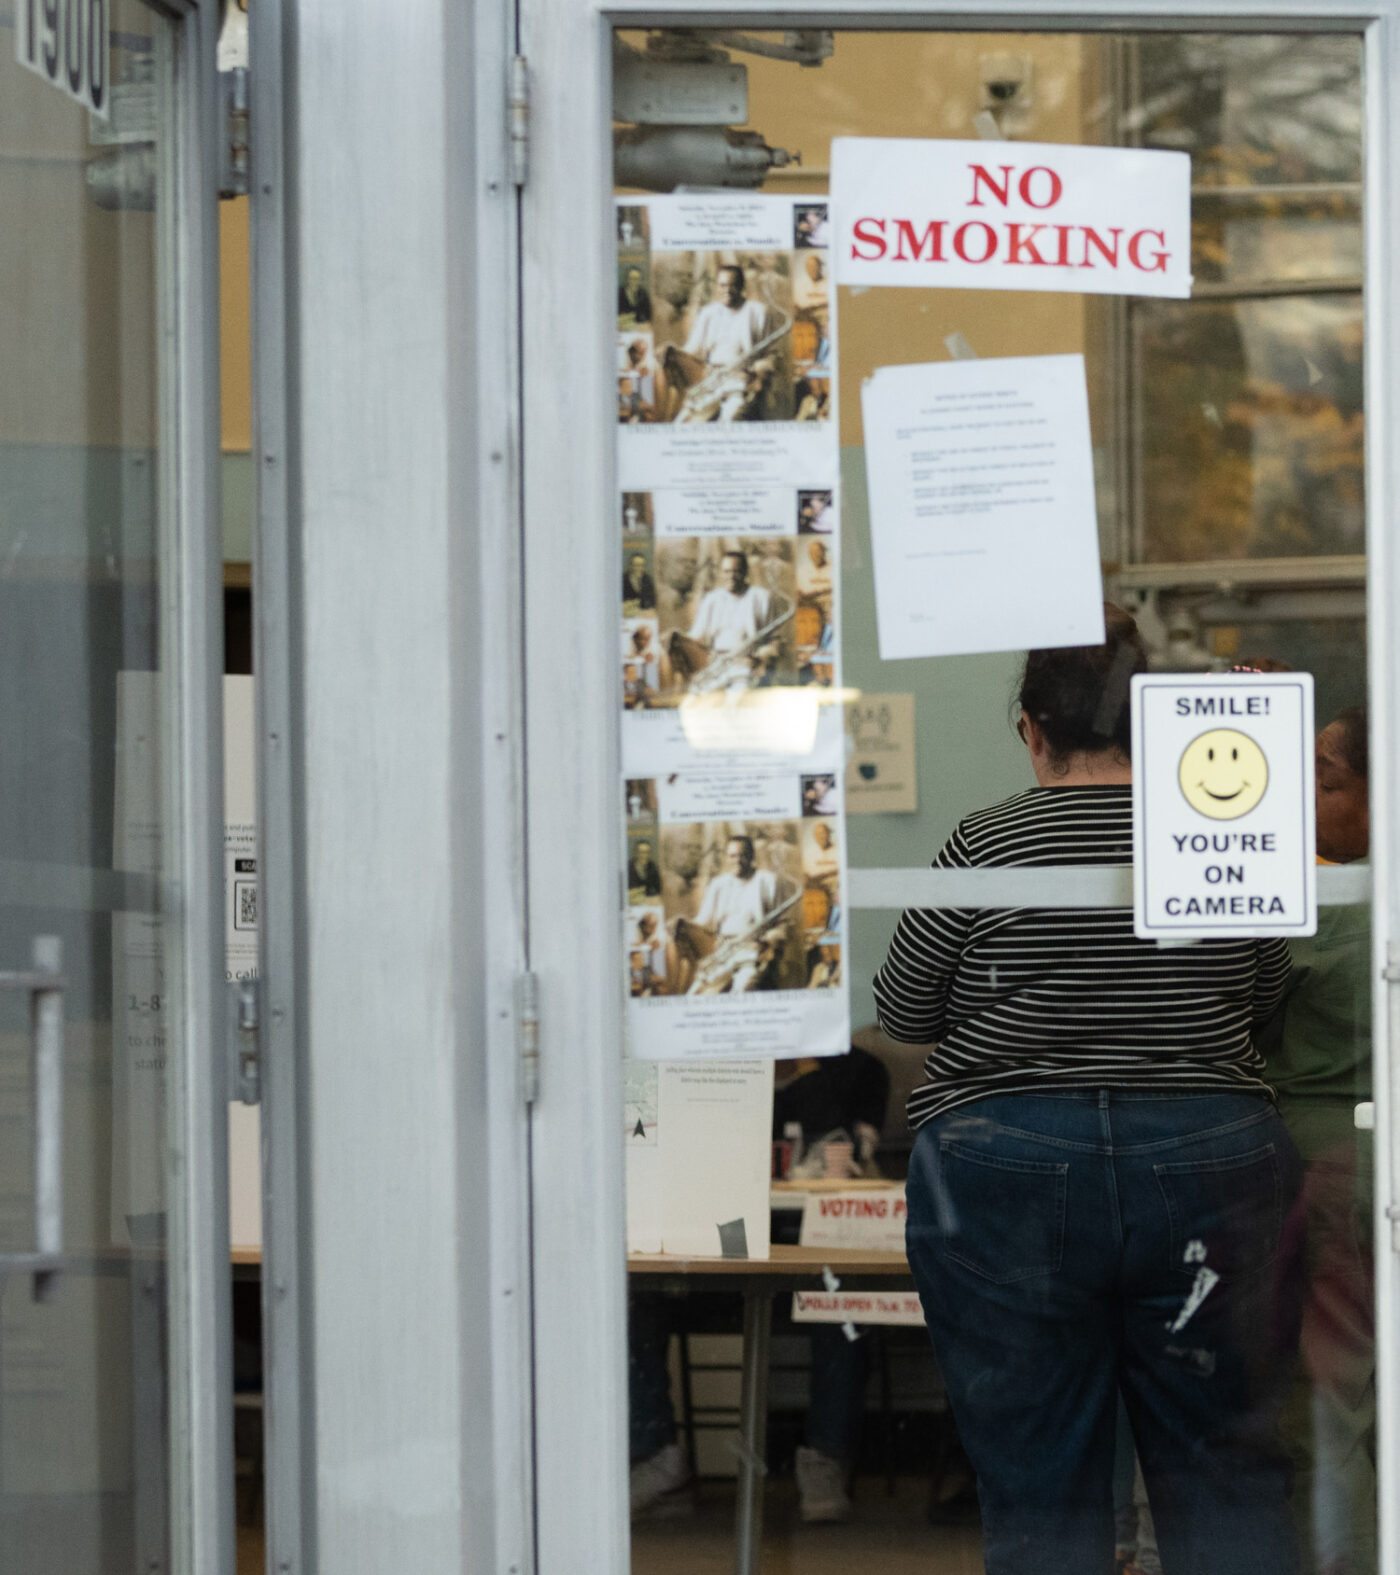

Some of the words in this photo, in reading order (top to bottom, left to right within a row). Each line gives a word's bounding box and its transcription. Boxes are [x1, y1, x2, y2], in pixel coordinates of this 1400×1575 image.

[966, 163, 1063, 210] NO
[851, 217, 1171, 273] SMOKING
[1176, 697, 1270, 716] SMILE!
[1172, 833, 1276, 853] YOU'RE
[1204, 865, 1244, 884] ON
[1165, 896, 1285, 916] CAMERA
[129, 994, 163, 1012] 1-8
[820, 1199, 888, 1218] VOTING
